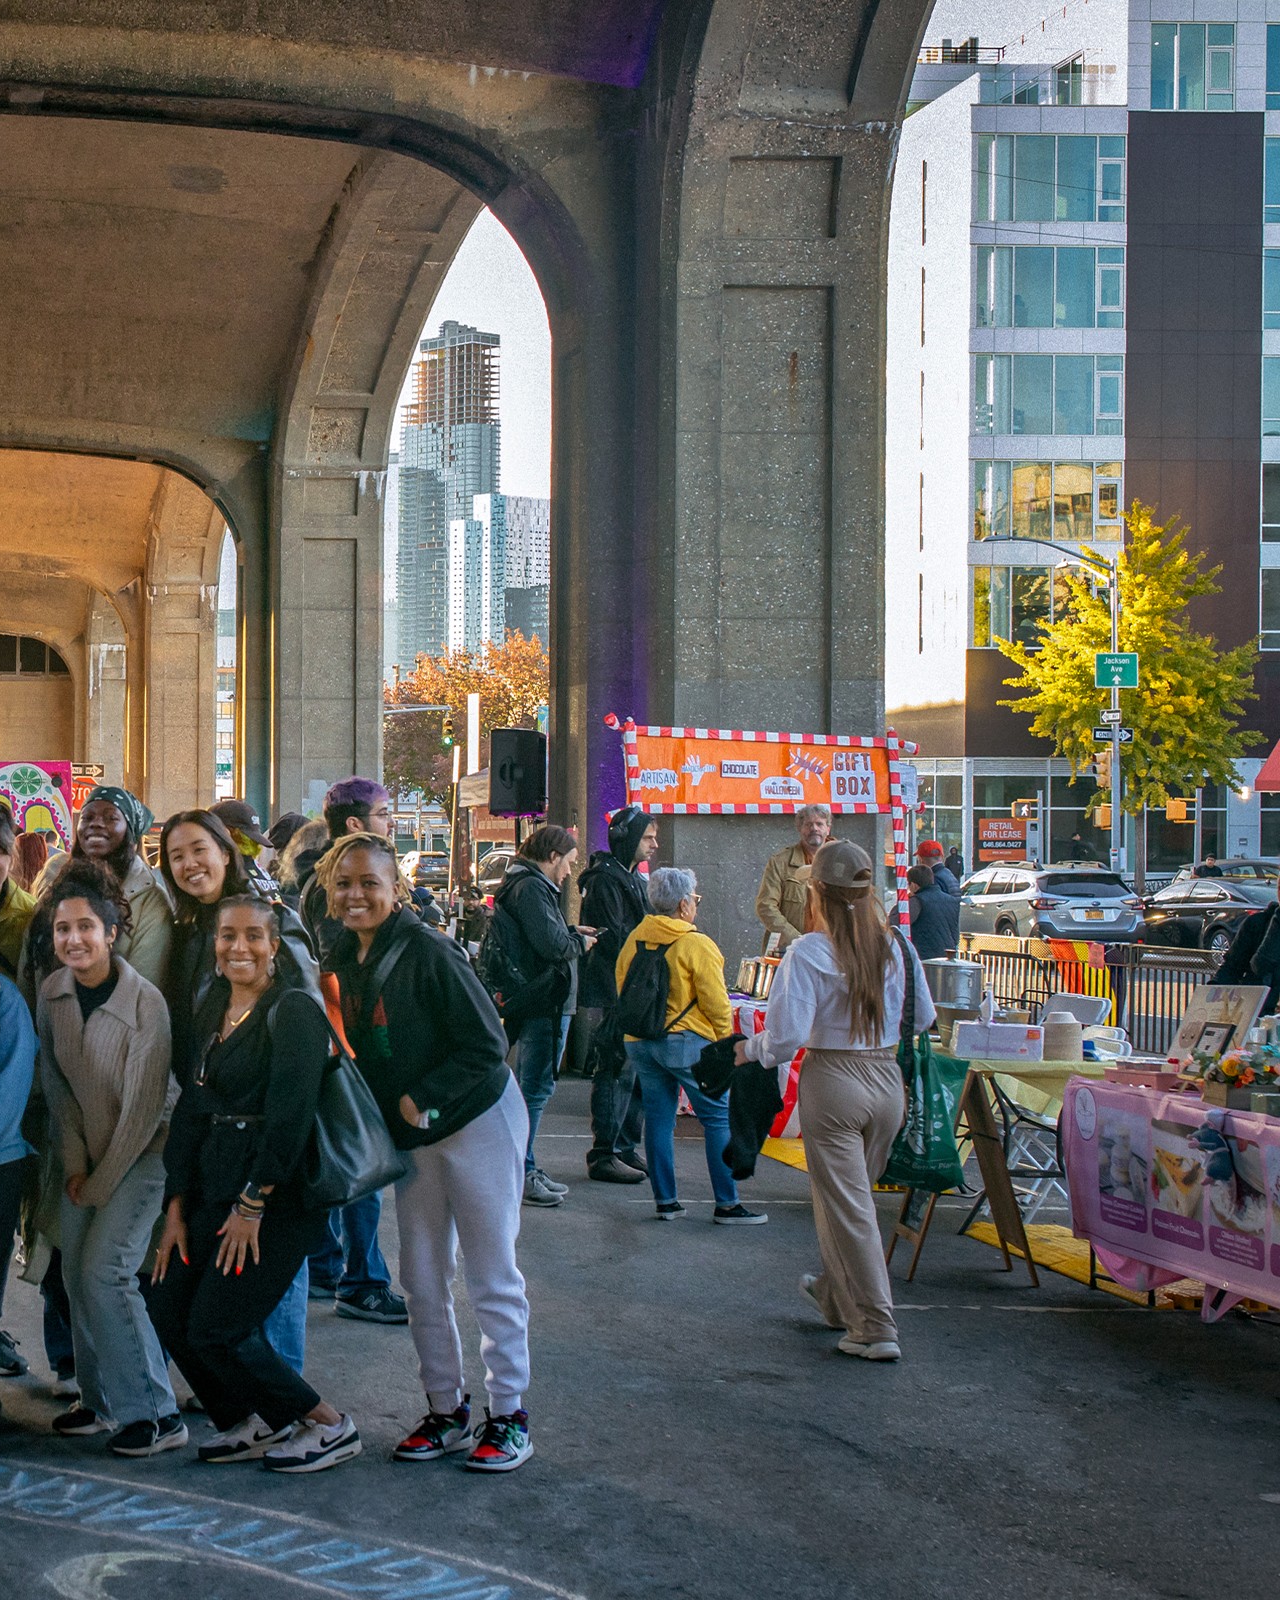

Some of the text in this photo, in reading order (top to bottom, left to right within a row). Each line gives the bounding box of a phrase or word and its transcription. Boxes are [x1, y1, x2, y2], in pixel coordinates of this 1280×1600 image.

[1104, 657, 1130, 665] Jackson
[834, 752, 871, 772] GIFT
[722, 763, 758, 776] CHOCOLATE
[641, 771, 676, 785] ARTISAN
[765, 785, 801, 796] HALLOWEEN
[836, 776, 871, 796] BOX
[72, 787, 95, 800] STO
[988, 822, 1014, 830] RETAIL
[982, 830, 998, 838] FOR
